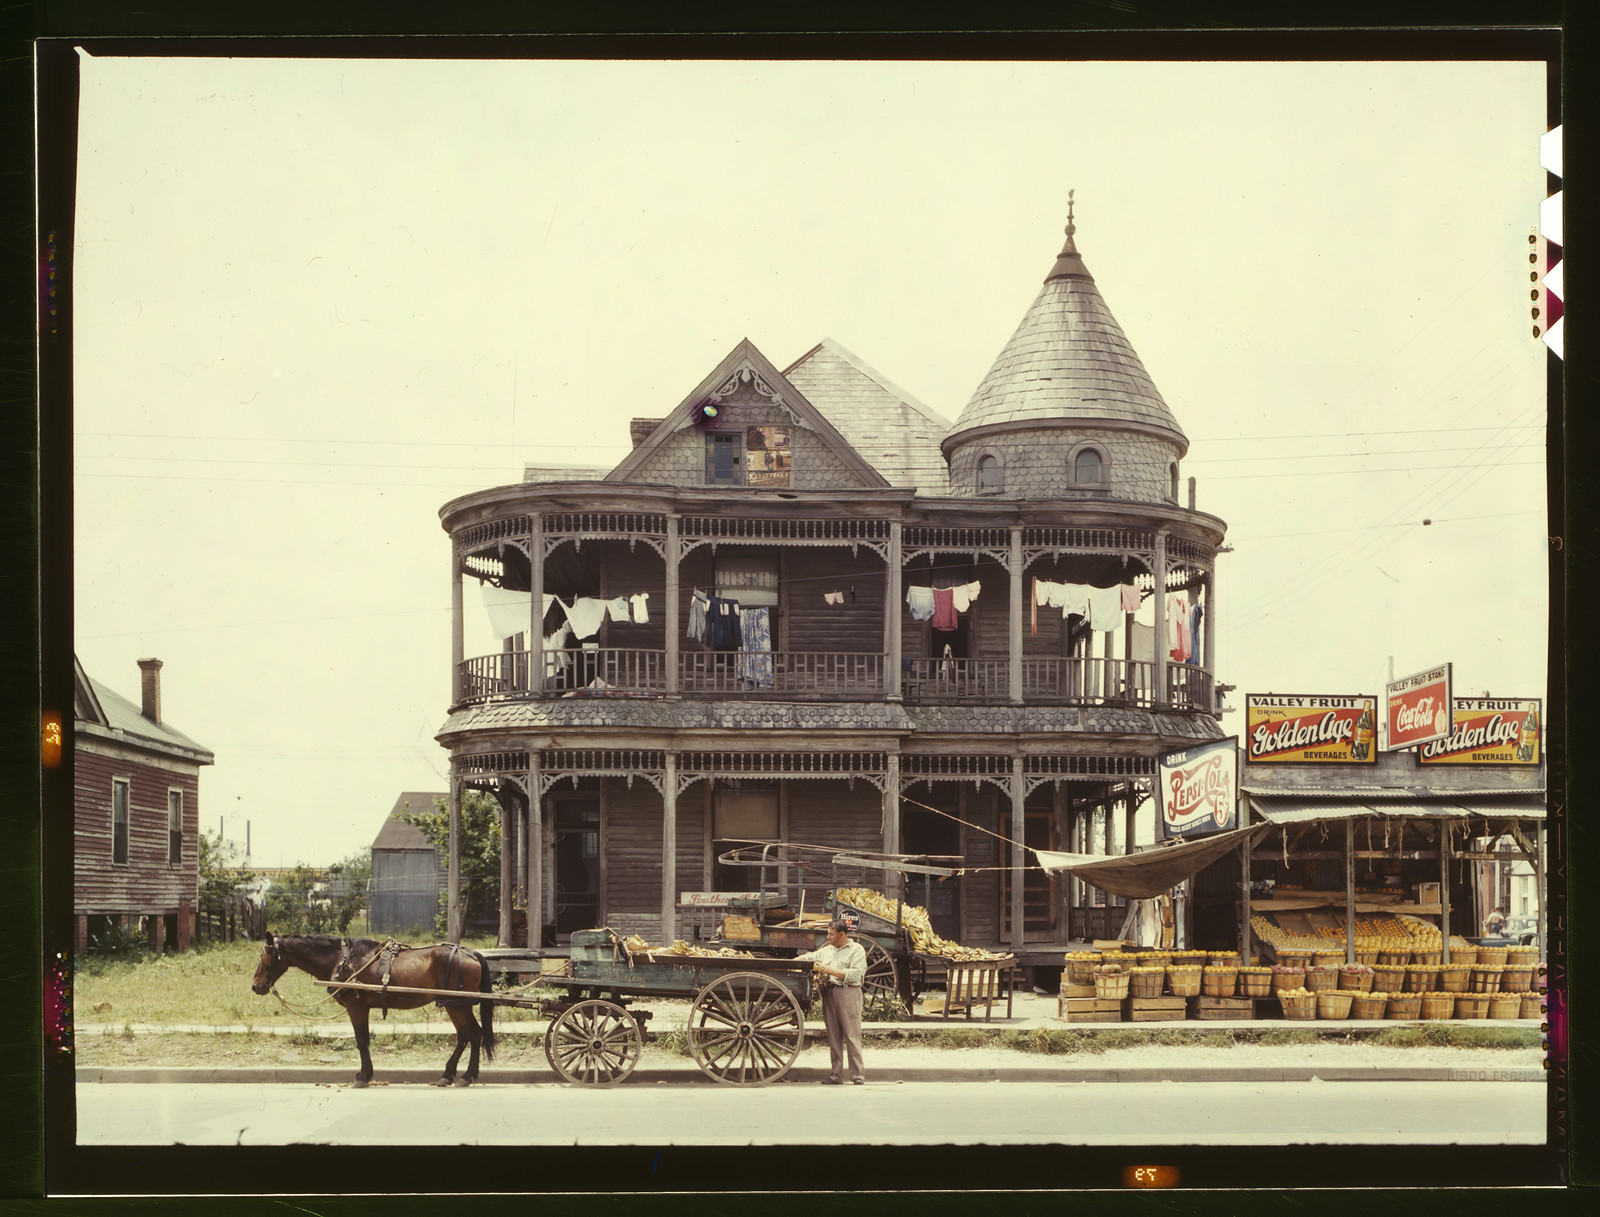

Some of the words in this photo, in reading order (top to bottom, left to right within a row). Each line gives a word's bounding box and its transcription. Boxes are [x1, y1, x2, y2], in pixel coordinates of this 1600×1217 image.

[1390, 682, 1408, 693] VALLEY
[1411, 676, 1426, 687] FRUIT
[1428, 668, 1445, 682] STAND
[1252, 697, 1304, 707] VALLEY
[1309, 698, 1357, 708] FRUIT
[1478, 701, 1521, 710] FRUIT
[1257, 709, 1287, 717] DRINK
[1397, 696, 1434, 733] Coca-Cola
[1252, 719, 1318, 756] Golden
[1319, 711, 1353, 744] Age
[1485, 714, 1519, 746] Age
[1166, 752, 1187, 765] DRINK
[1303, 751, 1347, 759] BEVERAGES
[1472, 753, 1513, 761] BEVERAGES
[689, 893, 728, 905] Souther
[840, 912, 859, 921] Hires
